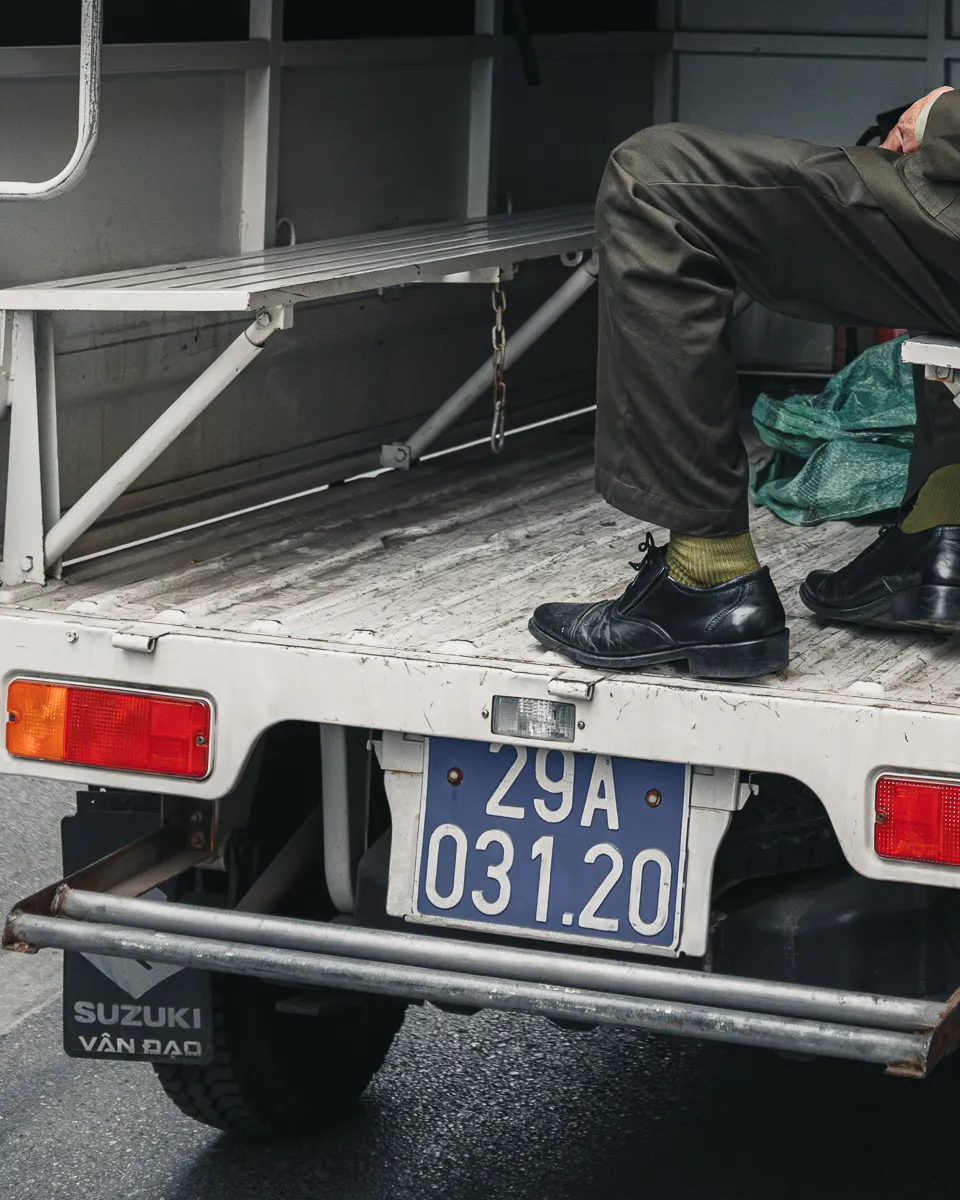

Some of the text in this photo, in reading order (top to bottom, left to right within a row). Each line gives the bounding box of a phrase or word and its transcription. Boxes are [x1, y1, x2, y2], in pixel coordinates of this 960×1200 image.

[485, 743, 620, 830] 29A
[425, 823, 672, 936] 031.20
[73, 1000, 202, 1029] SUZUKI
[78, 1032, 135, 1054] VÂN
